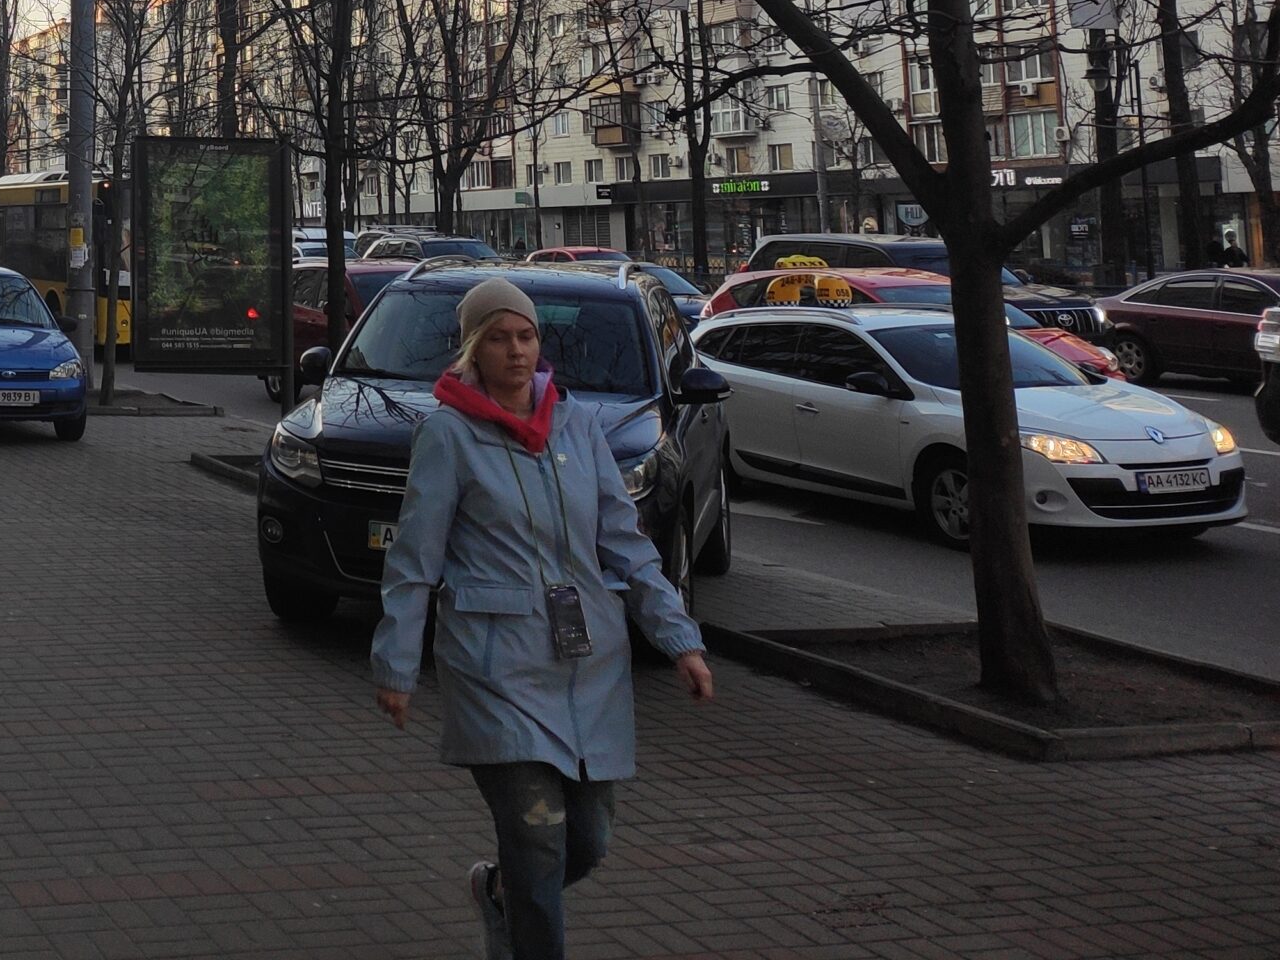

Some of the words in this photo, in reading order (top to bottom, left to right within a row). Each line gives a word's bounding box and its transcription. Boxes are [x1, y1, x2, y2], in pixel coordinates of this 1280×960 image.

[720, 179, 761, 193] miraton
[1, 391, 23, 402] 9839
[1147, 474, 1164, 488] AA
[1166, 473, 1190, 487] 4132
[1192, 472, 1207, 485] KC
[382, 527, 394, 545] A
